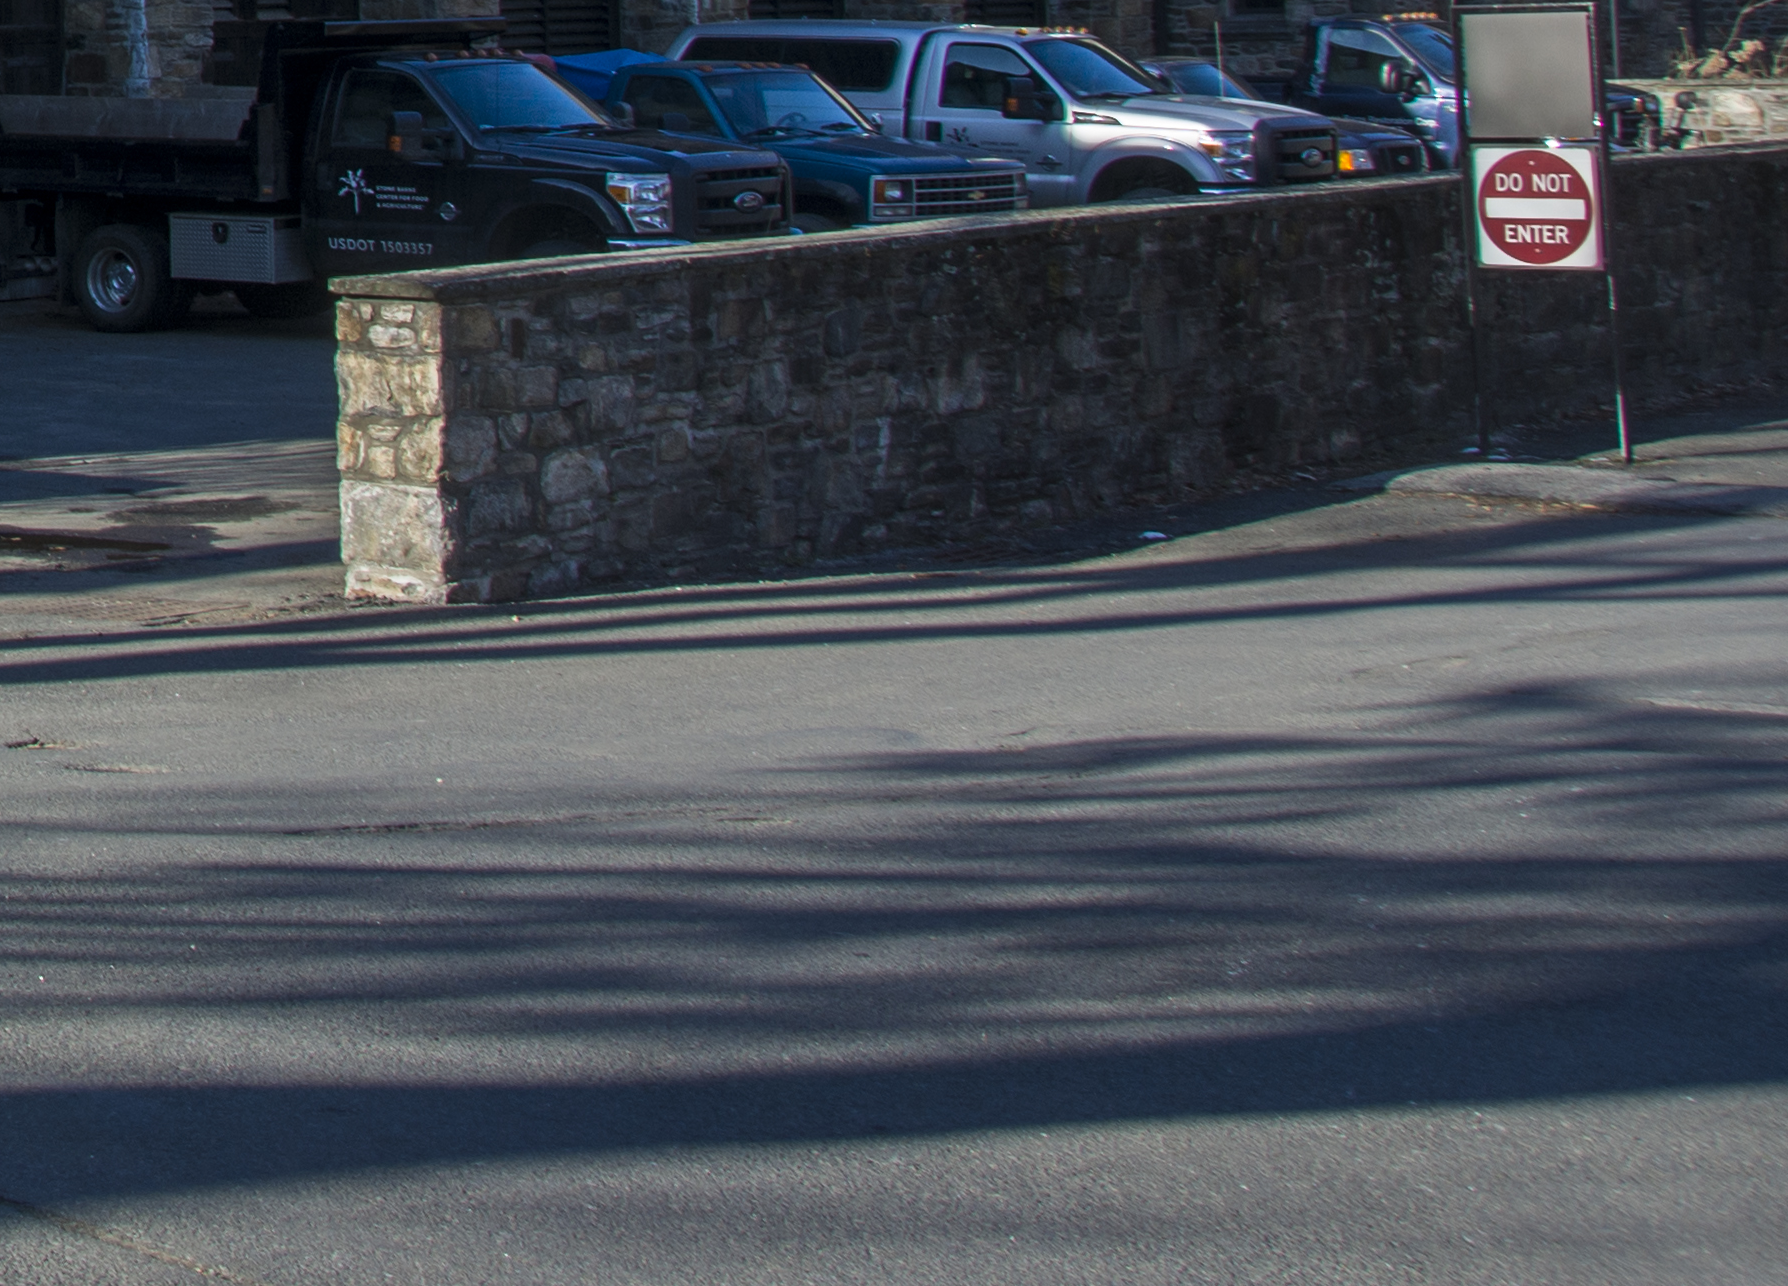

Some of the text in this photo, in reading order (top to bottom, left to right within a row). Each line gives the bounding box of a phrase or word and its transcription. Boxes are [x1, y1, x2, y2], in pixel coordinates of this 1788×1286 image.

[1494, 172, 1572, 193] DO NOT
[1504, 224, 1570, 244] ENTER
[328, 237, 433, 255] USDOT 1503357
